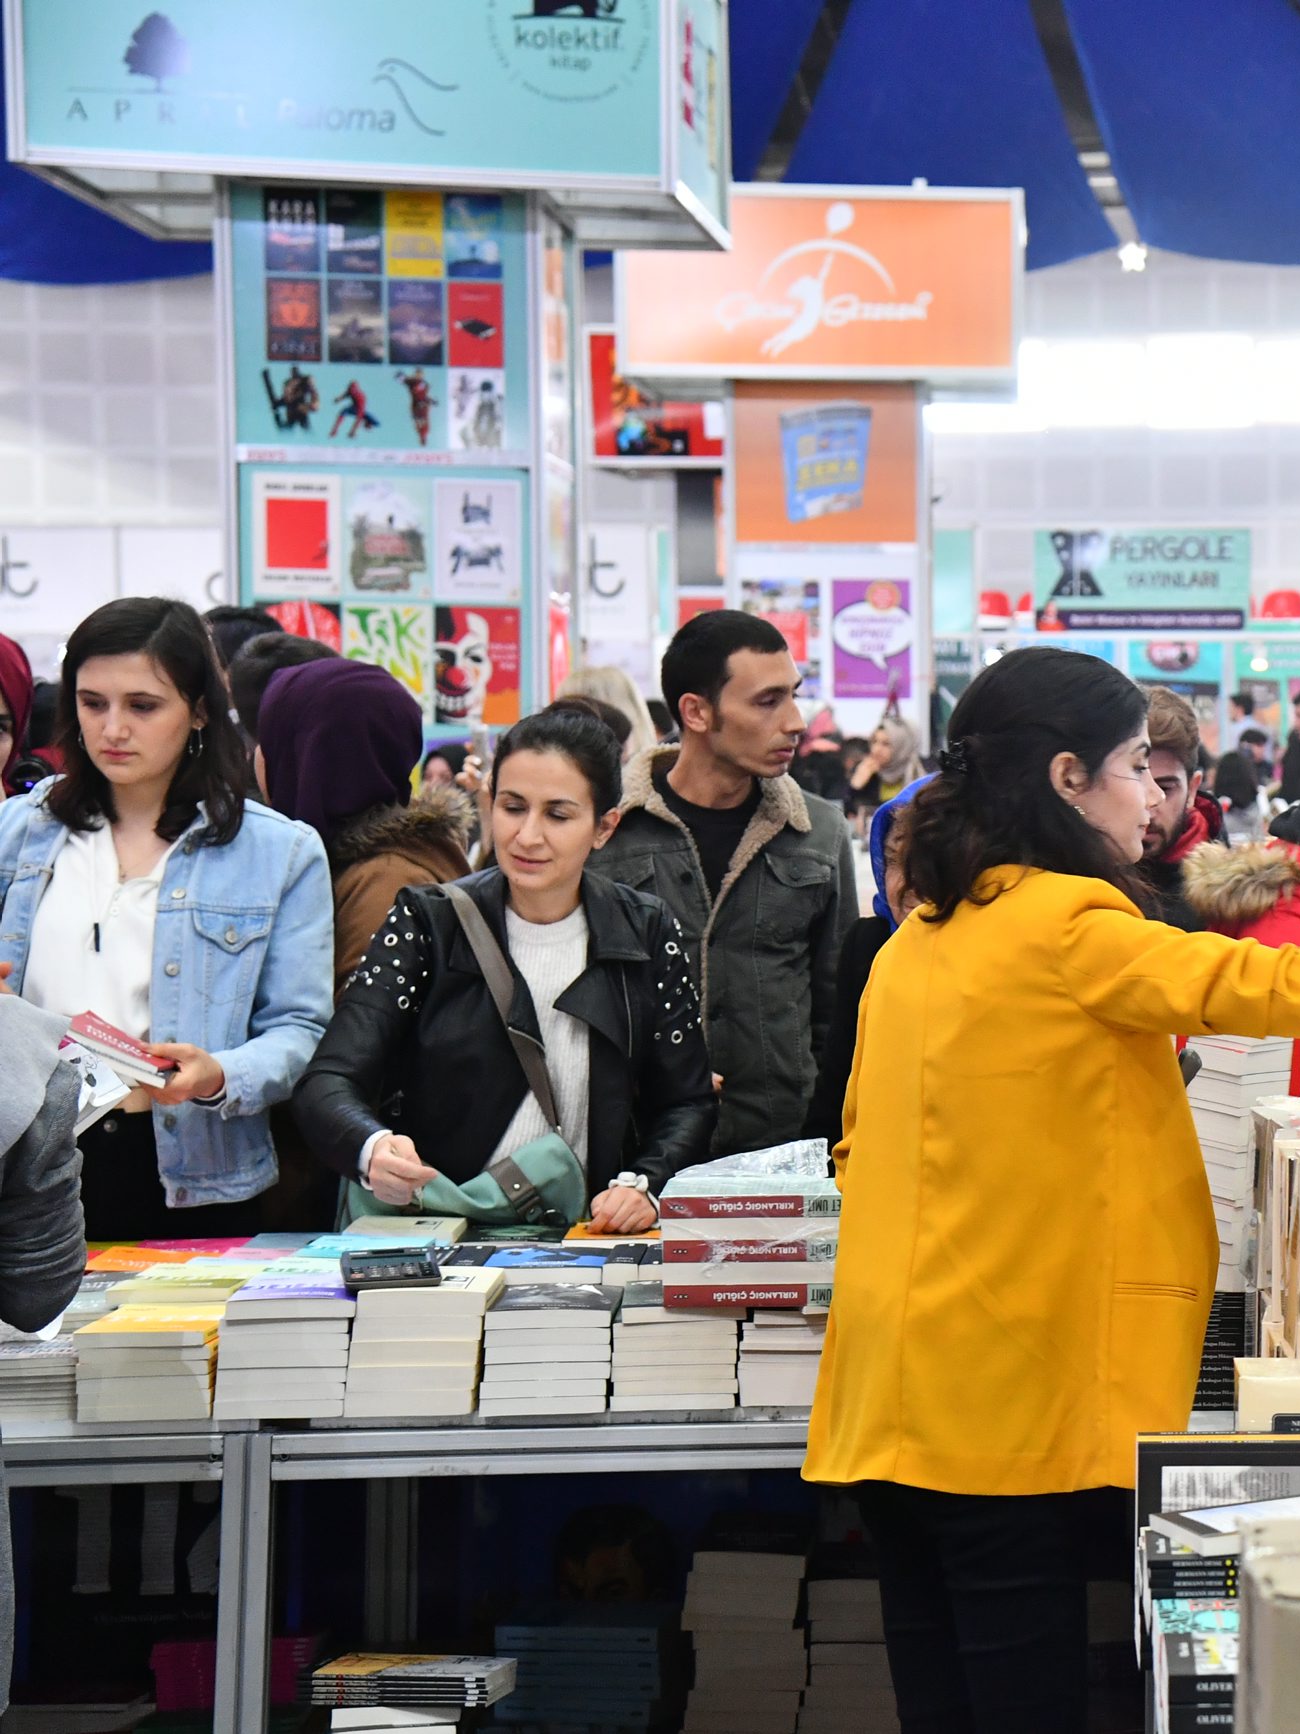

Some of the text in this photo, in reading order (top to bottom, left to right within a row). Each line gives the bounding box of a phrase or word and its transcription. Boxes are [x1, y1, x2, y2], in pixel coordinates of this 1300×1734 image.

[514, 26, 622, 50] kolektif
[550, 57, 592, 71] kitap
[1110, 535, 1233, 562] PERGOLE
[1127, 570, 1219, 588] YAYINLARI
[708, 1201, 744, 1213] ÇIĞLIĞI
[745, 1201, 795, 1212] KIRLANGIÇ
[713, 1290, 746, 1302] ÇIĞLIĞI
[749, 1290, 798, 1301] KIRLANGIÇ
[1197, 1682, 1233, 1692] OLIVER
[1197, 1714, 1233, 1725] OLIVER
